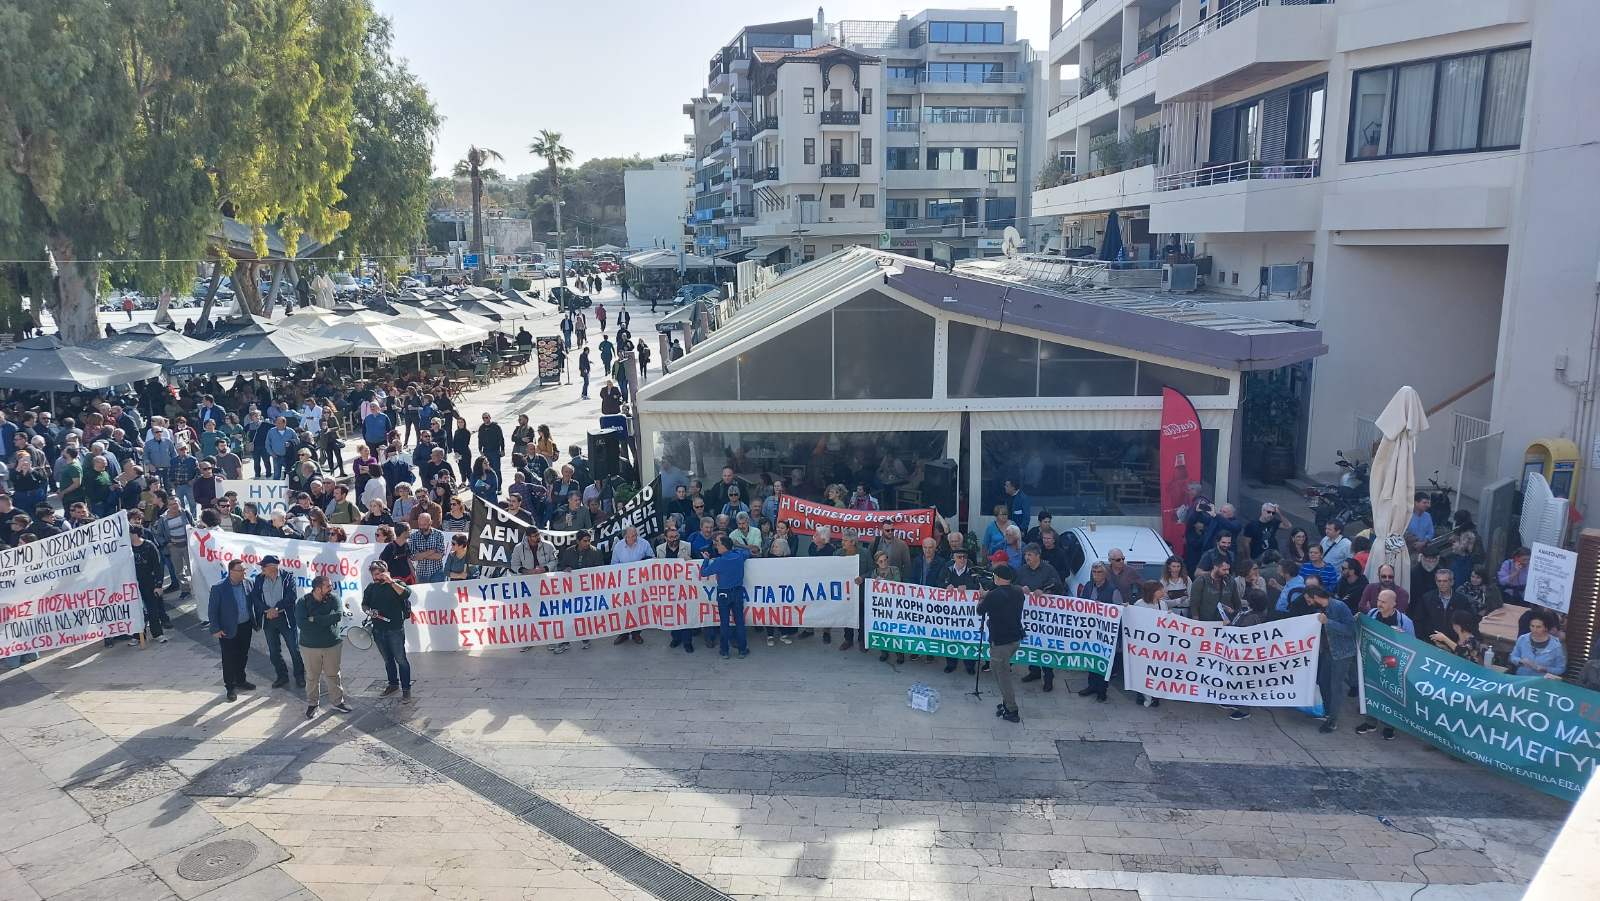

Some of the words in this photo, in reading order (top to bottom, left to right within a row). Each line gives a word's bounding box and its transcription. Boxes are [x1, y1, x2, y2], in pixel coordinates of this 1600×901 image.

[249, 485, 261, 498] Η
[480, 524, 518, 543] ΔΕΝ
[600, 501, 656, 539] ΚΑΝΕΙΣ
[781, 498, 791, 510] Η
[794, 500, 862, 522] Ιεράπετρα
[865, 512, 931, 525] διεκδικεί
[478, 543, 508, 562] ΝΑ
[457, 587, 469, 603] Η
[479, 581, 532, 601] ΥΓΕΙΑ
[539, 576, 573, 596] ΔΕΝ
[580, 569, 622, 592] ΕΙΝΑΙ
[872, 581, 906, 596] ΚΑΤΩ
[909, 583, 925, 599] ΤΑ
[928, 588, 968, 602] ΧΕΡΙΑ
[1028, 593, 1119, 619] ΝΟΣΟΚΟΜΕΙΟ
[410, 602, 532, 626] ΑΠΟΚΛΕΙΣΤΙΚΑ
[539, 595, 609, 617] ΔΗΜΟΣΙΑ
[612, 589, 637, 608] ΚΑΙ
[641, 584, 698, 601] ΔΩΡΕΑΝ
[754, 585, 776, 603] ΓΙΑ
[779, 584, 795, 603] ΤΟ
[802, 580, 851, 601] ΛΑΟ!
[872, 596, 892, 608] ΣΑΝ
[896, 599, 923, 612] ΚΟΡΗ
[1023, 608, 1119, 634] ΡΟΣΤΑΤΕΥΣΟΥΜΕ
[459, 620, 565, 647] ΣΥΝΔΙΚΑΤΟ
[574, 604, 688, 638] ΟΙΚΟΔΟΜΩΝ
[872, 608, 893, 619] ΤΗΝ
[896, 611, 975, 628] ΑΚΕΡΑΙΟΤΗΤΑ
[1023, 621, 1092, 640] ΣΟΚΟΜΕΙΟΥ
[872, 620, 926, 636] ΔΩΡΕΑΝ
[1047, 638, 1065, 651] ΣΕ
[1124, 626, 1161, 644] ΑΠΟ
[1168, 634, 1191, 649] ΤΟ
[1156, 616, 1205, 637] ΚΑΤΩ
[1228, 627, 1284, 645] ΧΕΡΙΑ
[1015, 649, 1107, 673] ΡΕΘΥΜΝΟ
[1127, 643, 1189, 665] ΚΑΜΙΑ
[1145, 677, 1200, 697] ΕΛΜΕ
[1207, 688, 1297, 702] Ηρακλείου
[1147, 664, 1295, 690] ΝΟΣΟΚΟΜΕΙΩΝ
[1419, 656, 1540, 703] ΣΤΗΡΙΖΟΥΜΕ
[1545, 691, 1575, 712] ΤΟ
[1414, 680, 1550, 732] ΦΑΡΜΑΚΟ
[1415, 701, 1429, 721] Η
[1495, 759, 1514, 773] ΤΟΥ
